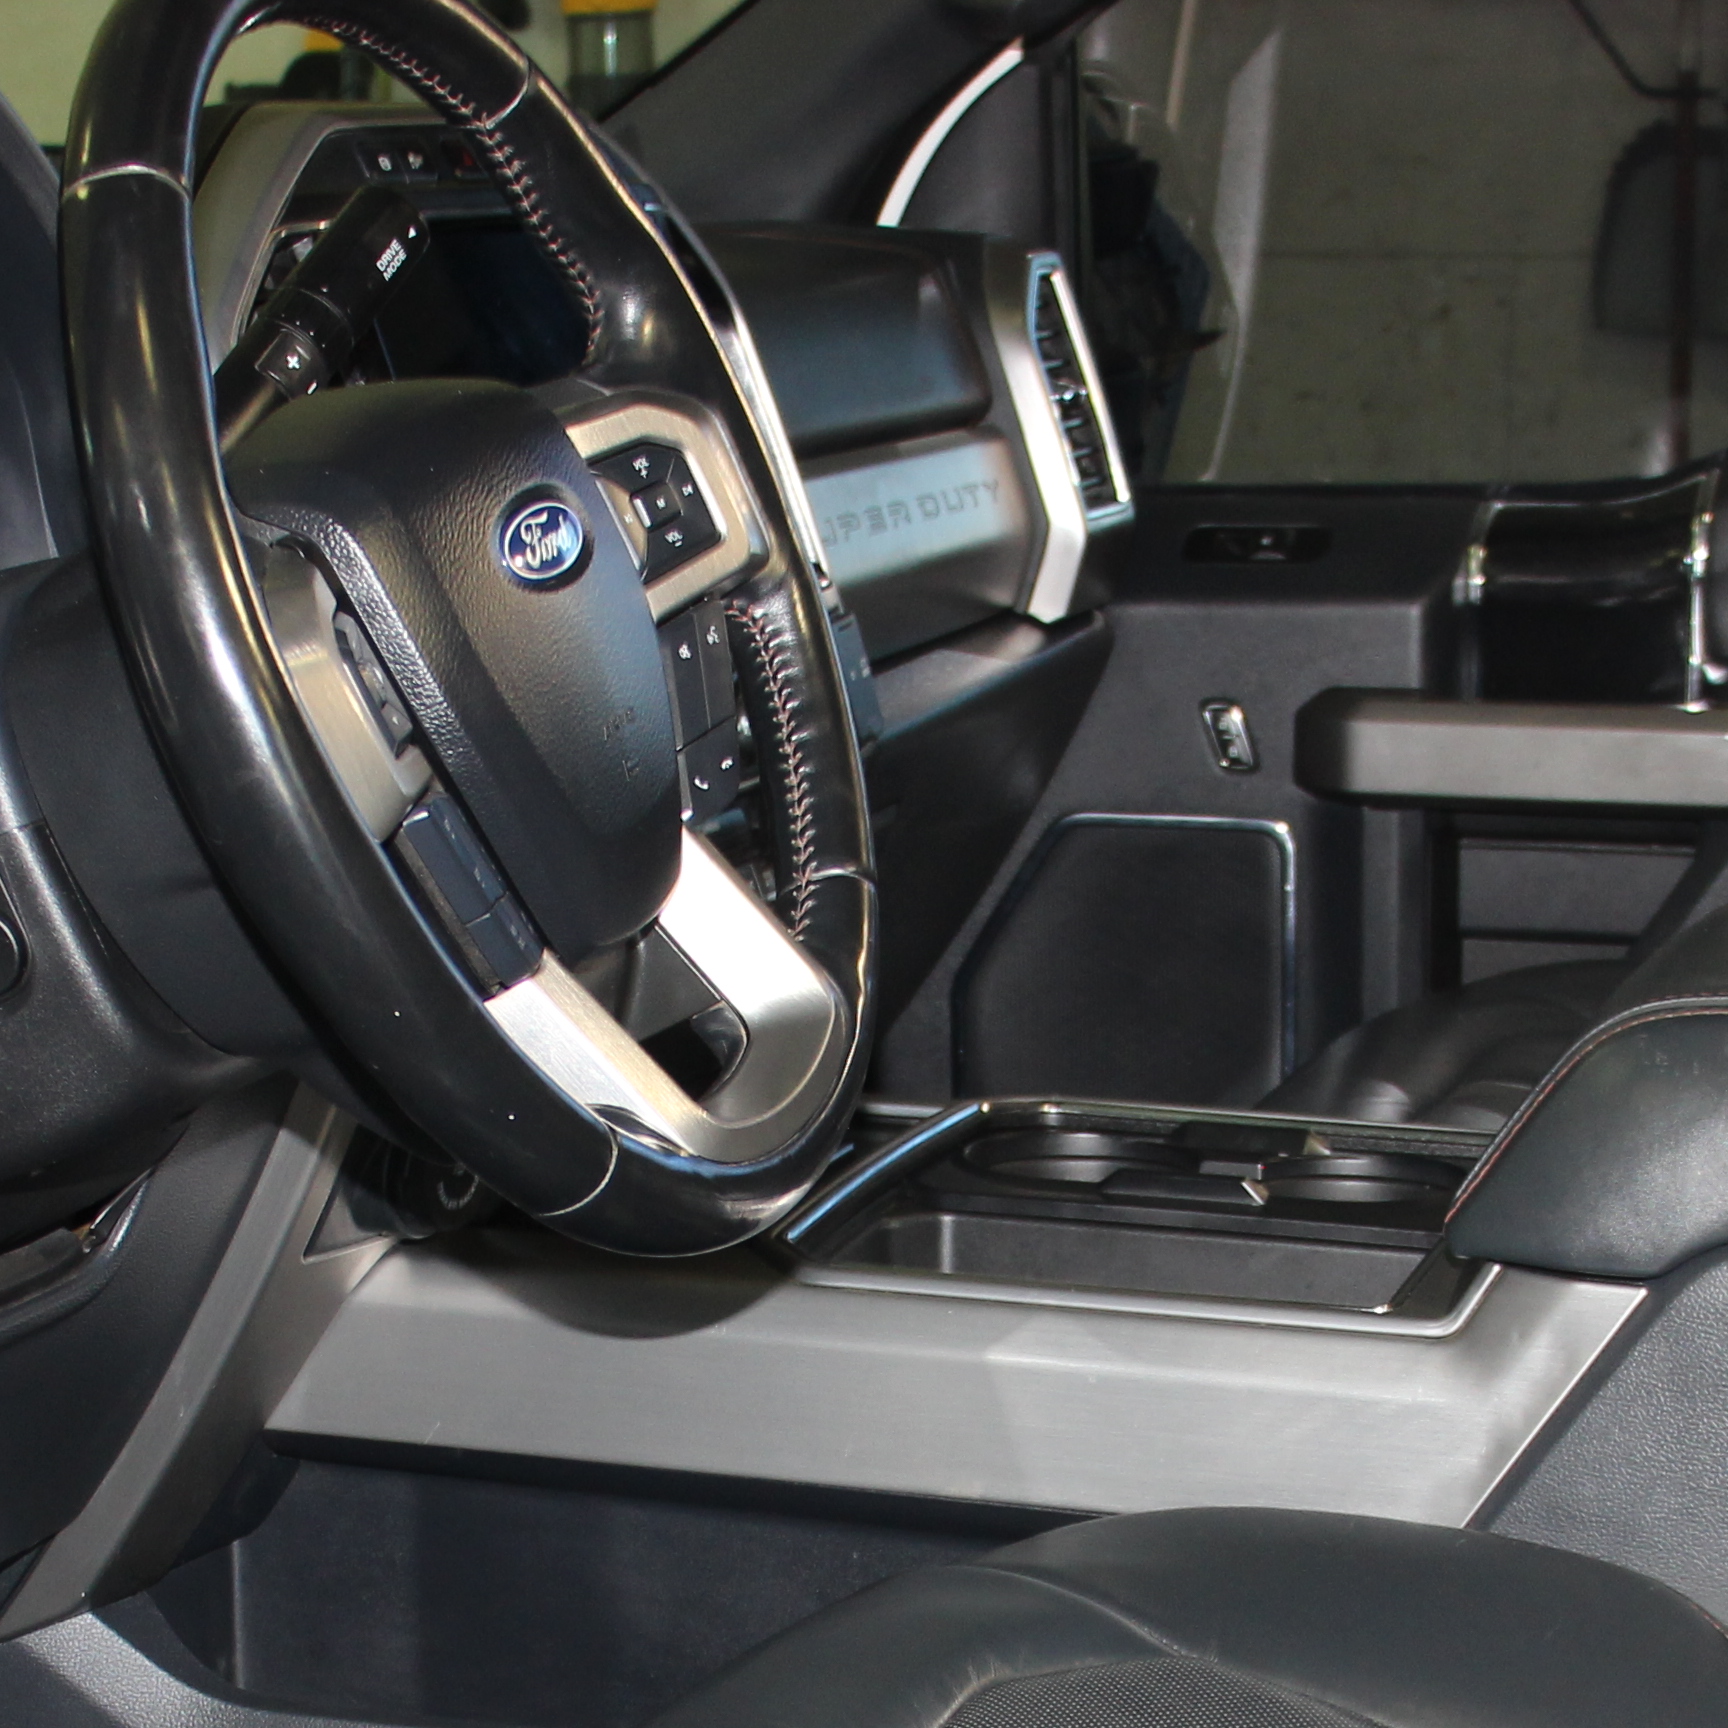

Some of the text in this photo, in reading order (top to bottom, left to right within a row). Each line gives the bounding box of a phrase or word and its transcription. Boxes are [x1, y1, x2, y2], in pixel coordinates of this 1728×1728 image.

[375, 238, 402, 272] DRIVE
[382, 248, 407, 282] MODE
[822, 479, 1000, 547] UPER DUTY
[519, 509, 572, 570] Ford
